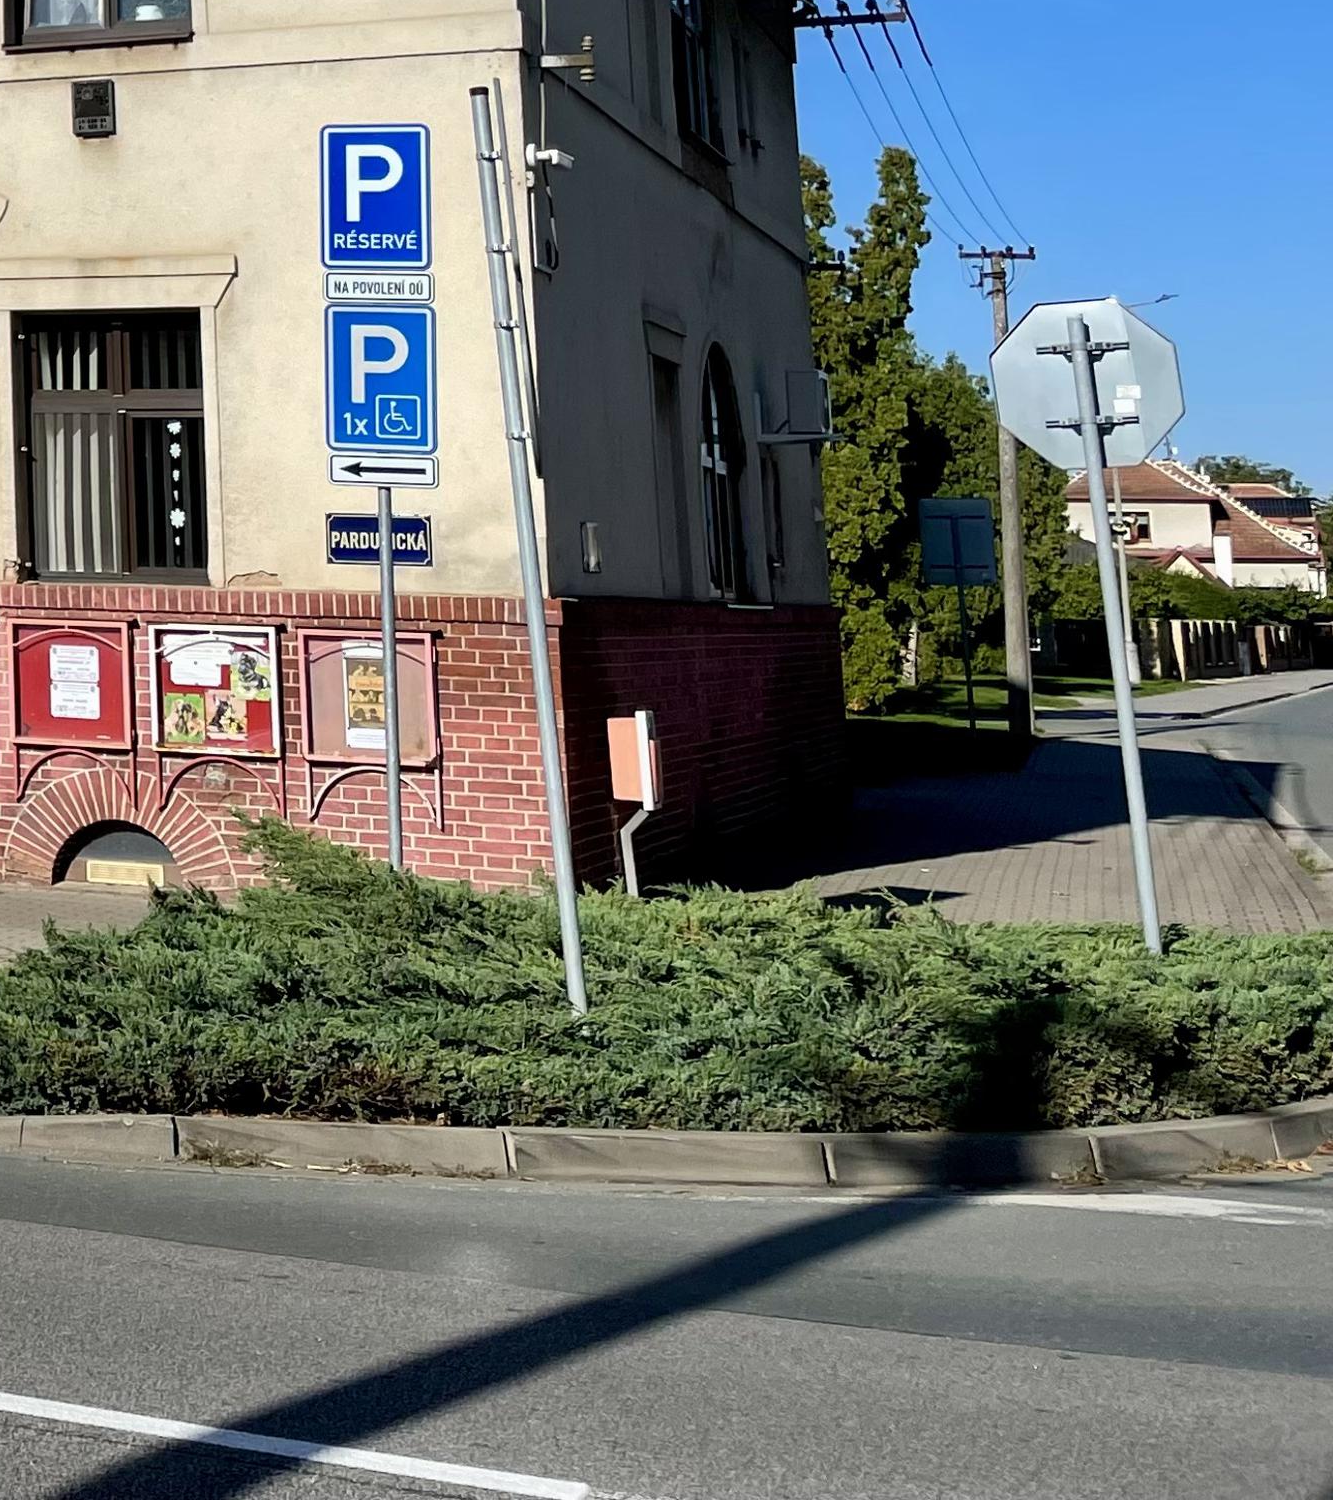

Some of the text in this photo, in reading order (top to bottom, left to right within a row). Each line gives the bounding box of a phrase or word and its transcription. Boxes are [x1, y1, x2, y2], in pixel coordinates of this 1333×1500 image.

[345, 144, 404, 222] P
[333, 230, 418, 250] RÉSERVÉ
[334, 279, 424, 296] NA POVOLENÍ OÚ
[350, 324, 409, 404] P
[343, 412, 369, 436] 1x
[331, 530, 427, 551] PARDUICKÁ
